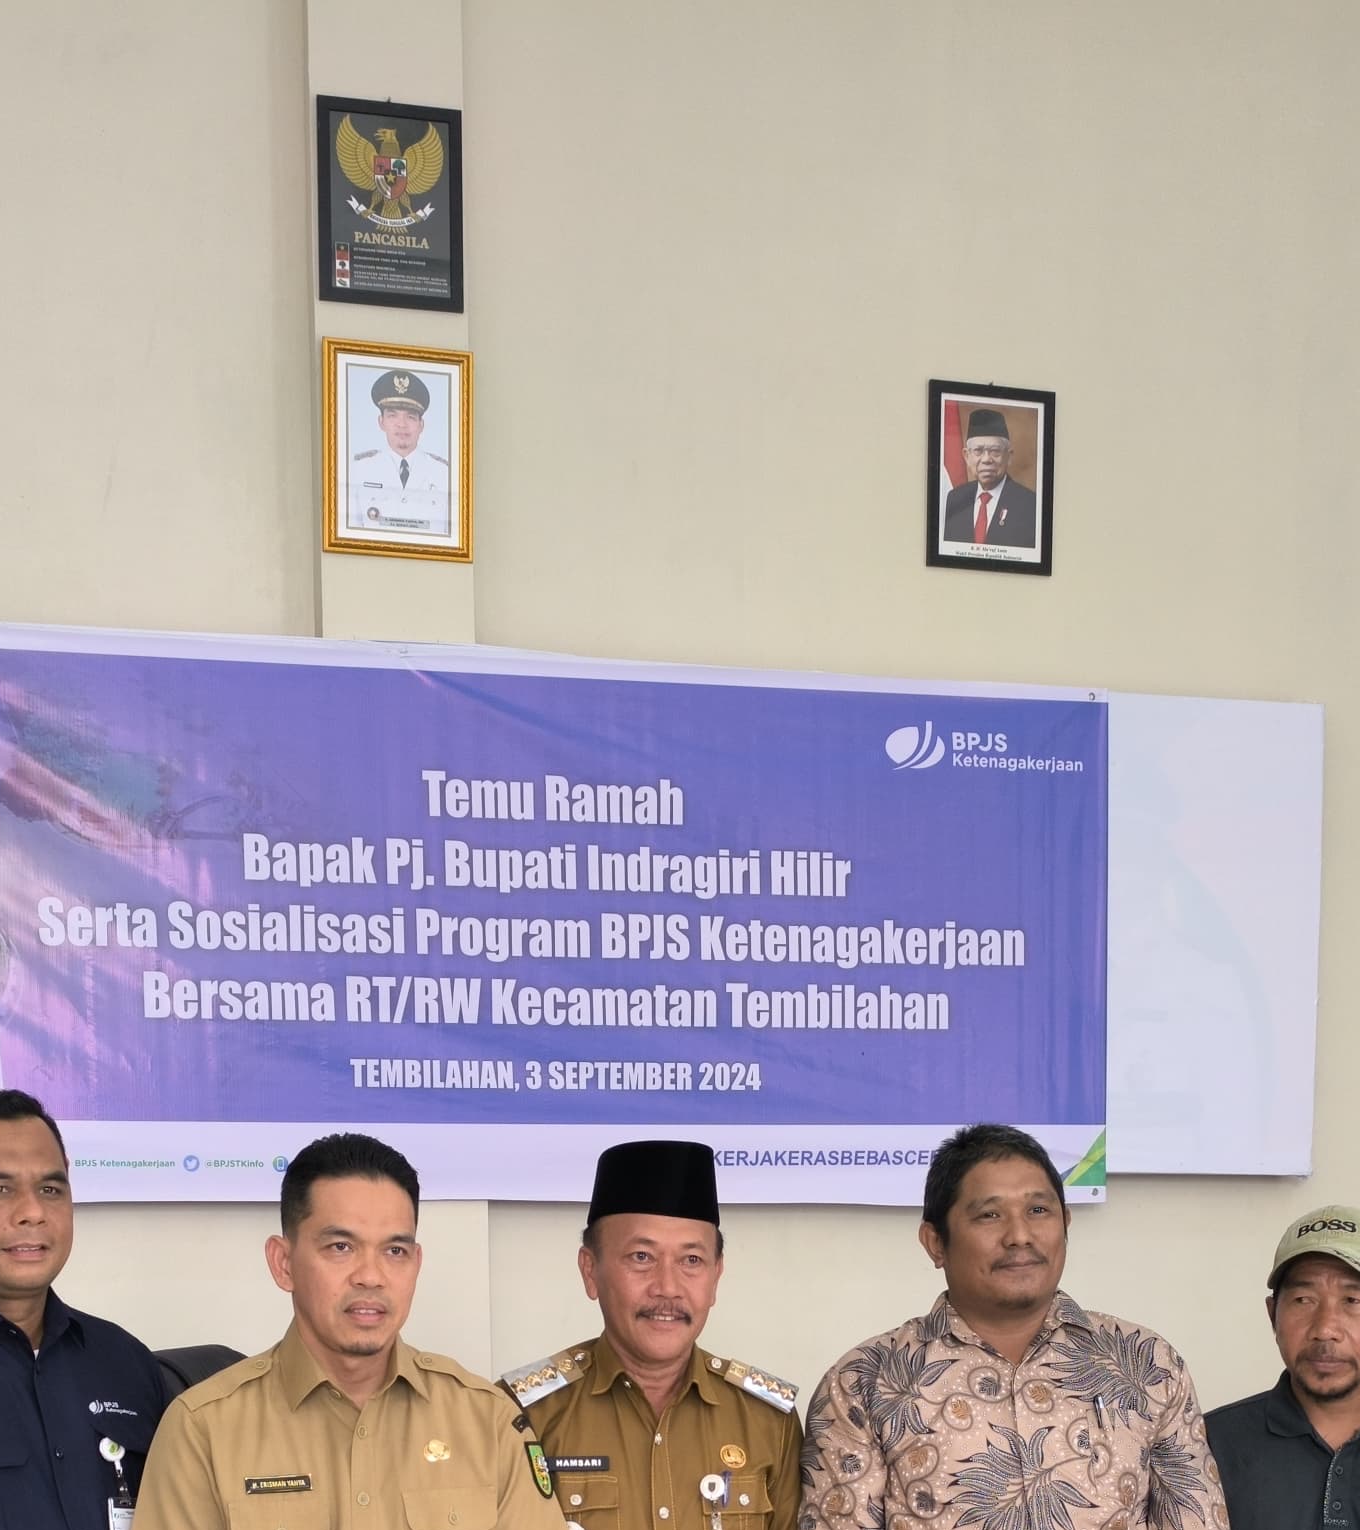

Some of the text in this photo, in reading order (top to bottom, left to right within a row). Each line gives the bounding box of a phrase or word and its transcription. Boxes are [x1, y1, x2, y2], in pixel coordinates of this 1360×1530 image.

[354, 231, 430, 249] PANCASILA
[951, 731, 1008, 753] BPJS
[952, 753, 1084, 773] Ketenagakerjaan
[421, 769, 684, 826] Temu Ramah
[243, 833, 852, 899] Bapak Pj. Bupati Indragiri Hilir
[38, 896, 1026, 970] Serta Sosialisasi Program BPJS Ketenagakerjaan
[142, 970, 950, 1031] Bersama RT/RW Kecamatan Tembilahan
[350, 1058, 762, 1093] TEMBILAHAN, 3 SEPTEMBER 2024
[74, 1158, 176, 1170] BPJS Ketenagakerjaan
[206, 1159, 265, 1170] @BPJSTKinfo
[555, 1458, 602, 1468] HAMSARI
